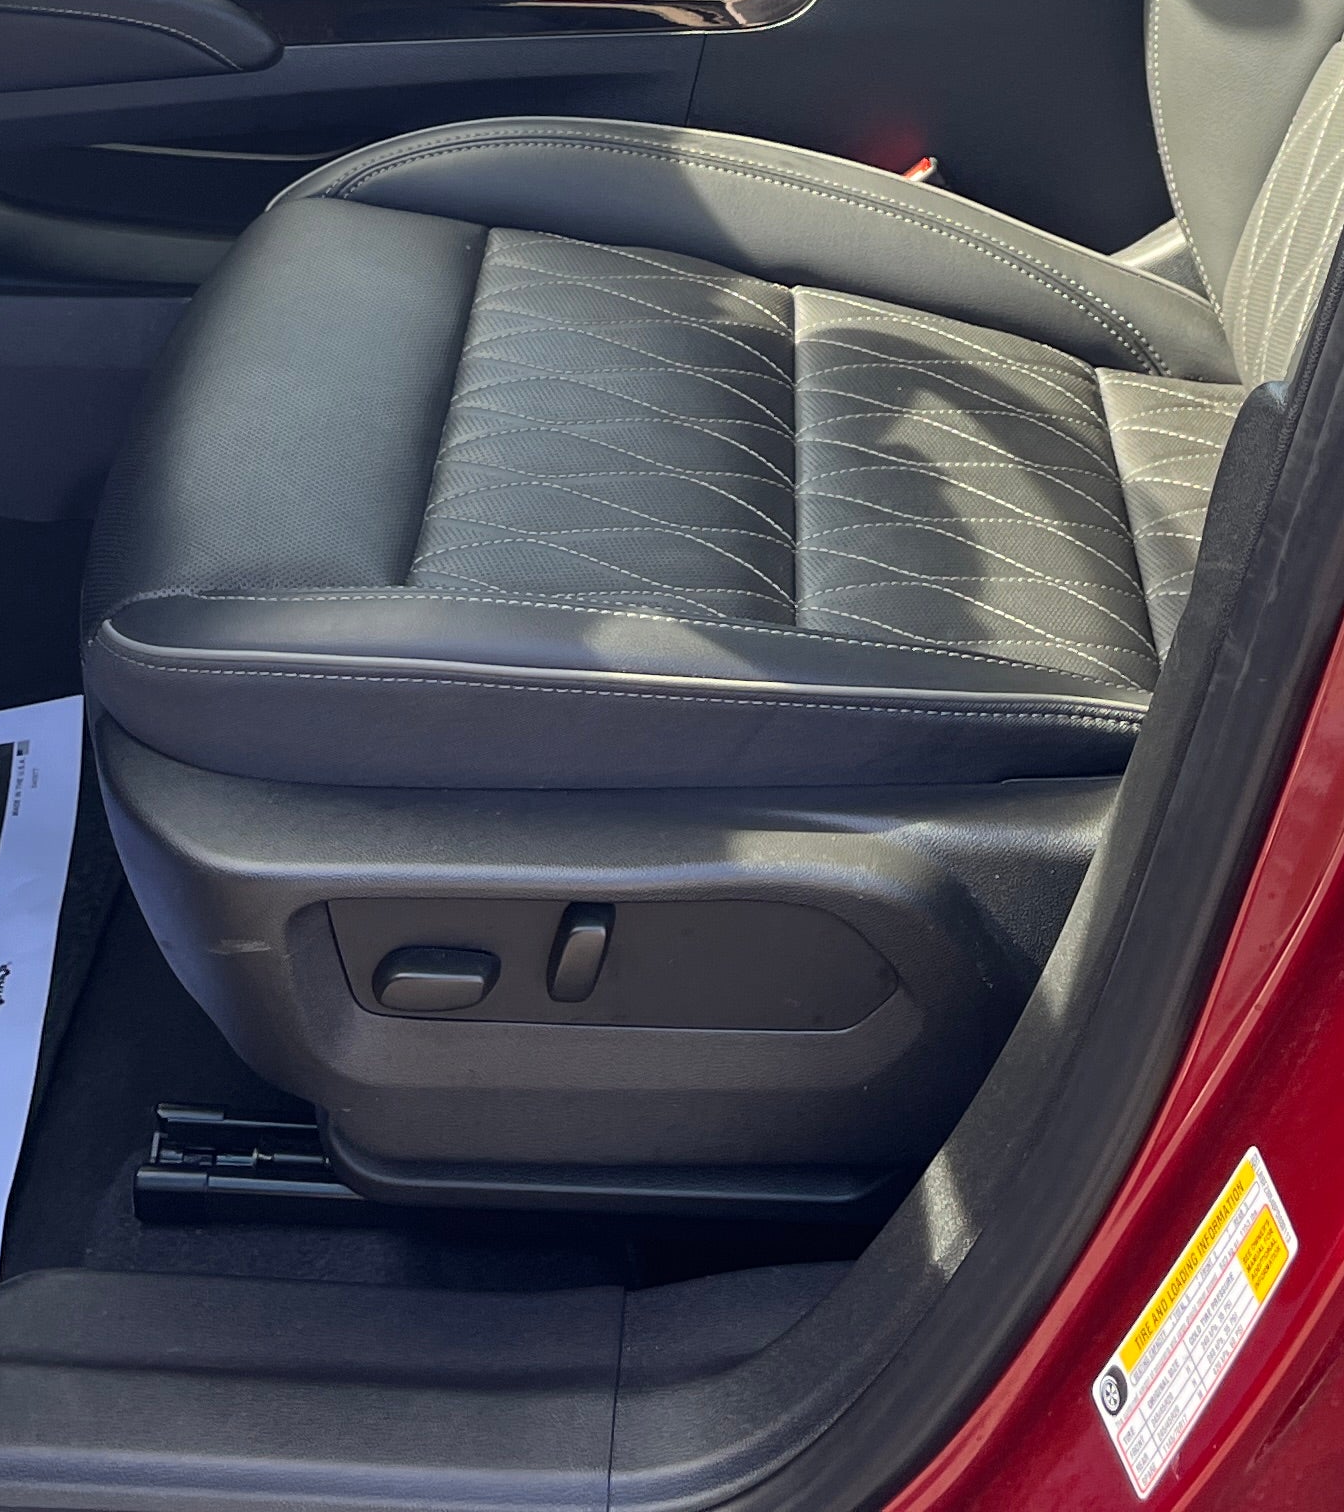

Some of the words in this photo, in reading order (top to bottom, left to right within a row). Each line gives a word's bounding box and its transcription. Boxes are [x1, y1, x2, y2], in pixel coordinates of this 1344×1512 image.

[1134, 1319, 1153, 1352] TIRE
[1150, 1295, 1168, 1326] AND
[1165, 1249, 1199, 1303] LOADING
[1195, 1179, 1245, 1258] INFORMATION
